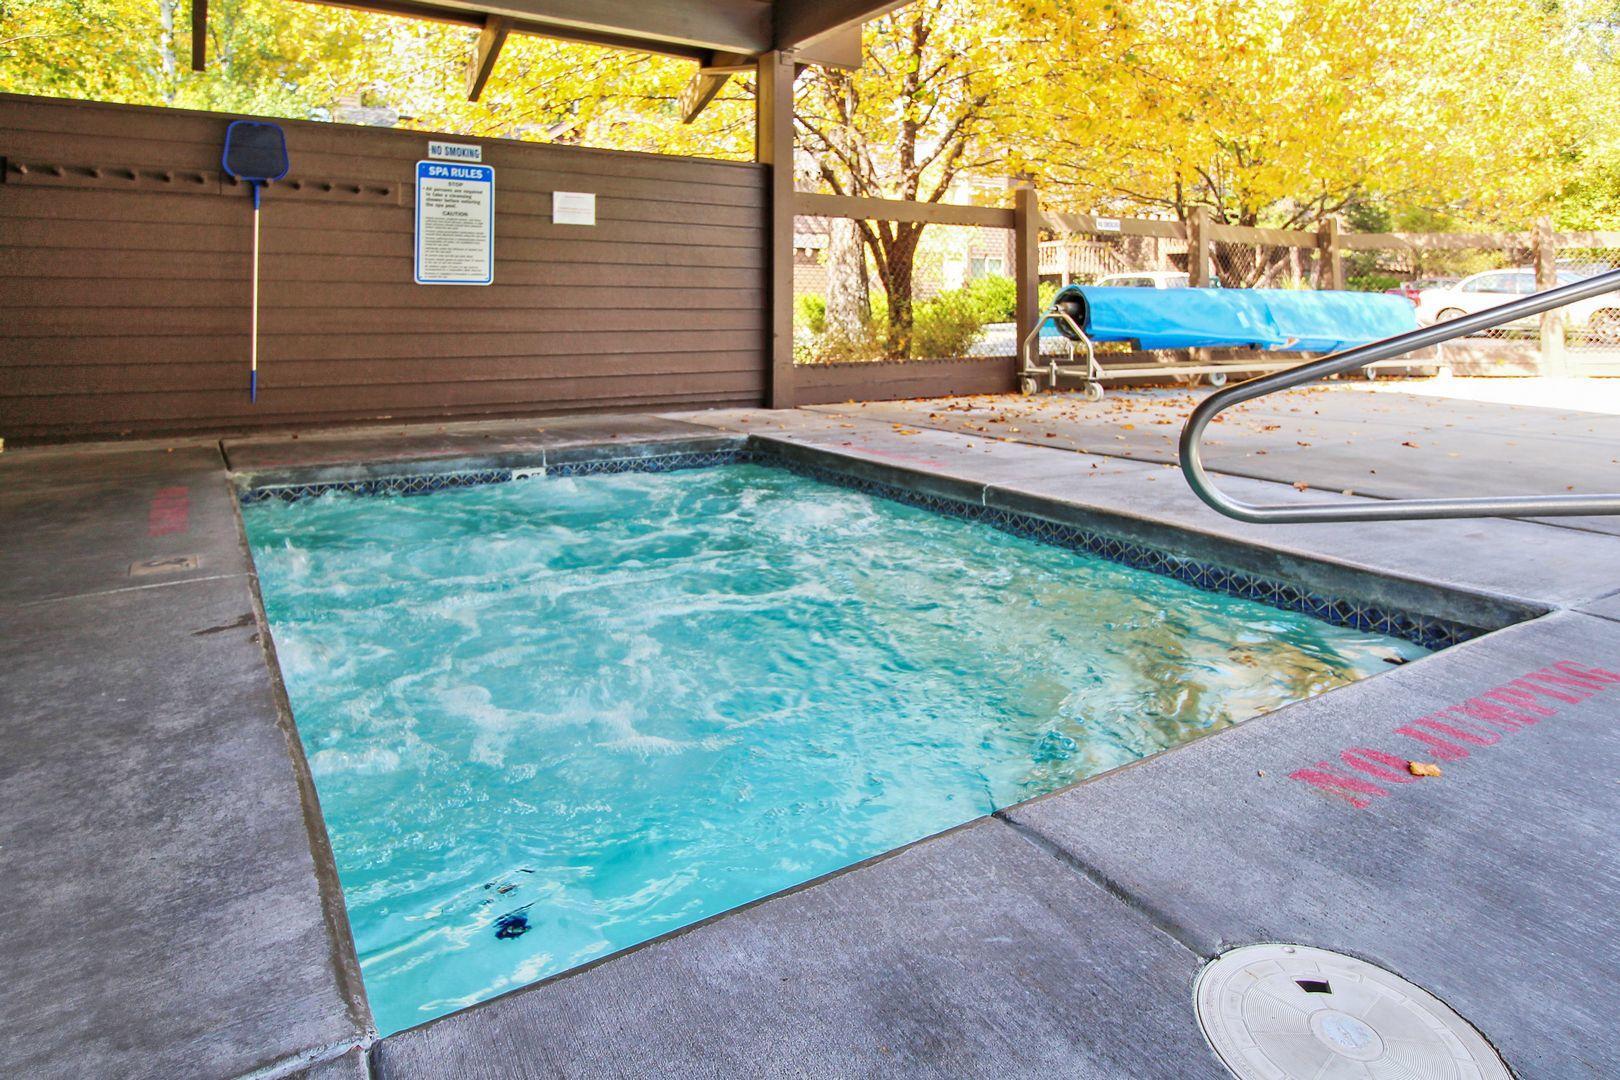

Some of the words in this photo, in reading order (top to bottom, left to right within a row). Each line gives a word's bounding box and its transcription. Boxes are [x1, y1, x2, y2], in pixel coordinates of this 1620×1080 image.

[431, 145, 442, 155] NO
[445, 146, 480, 159] SMOKING
[428, 166, 449, 177] SPA
[451, 168, 484, 179] RULES
[1288, 746, 1425, 809] NO
